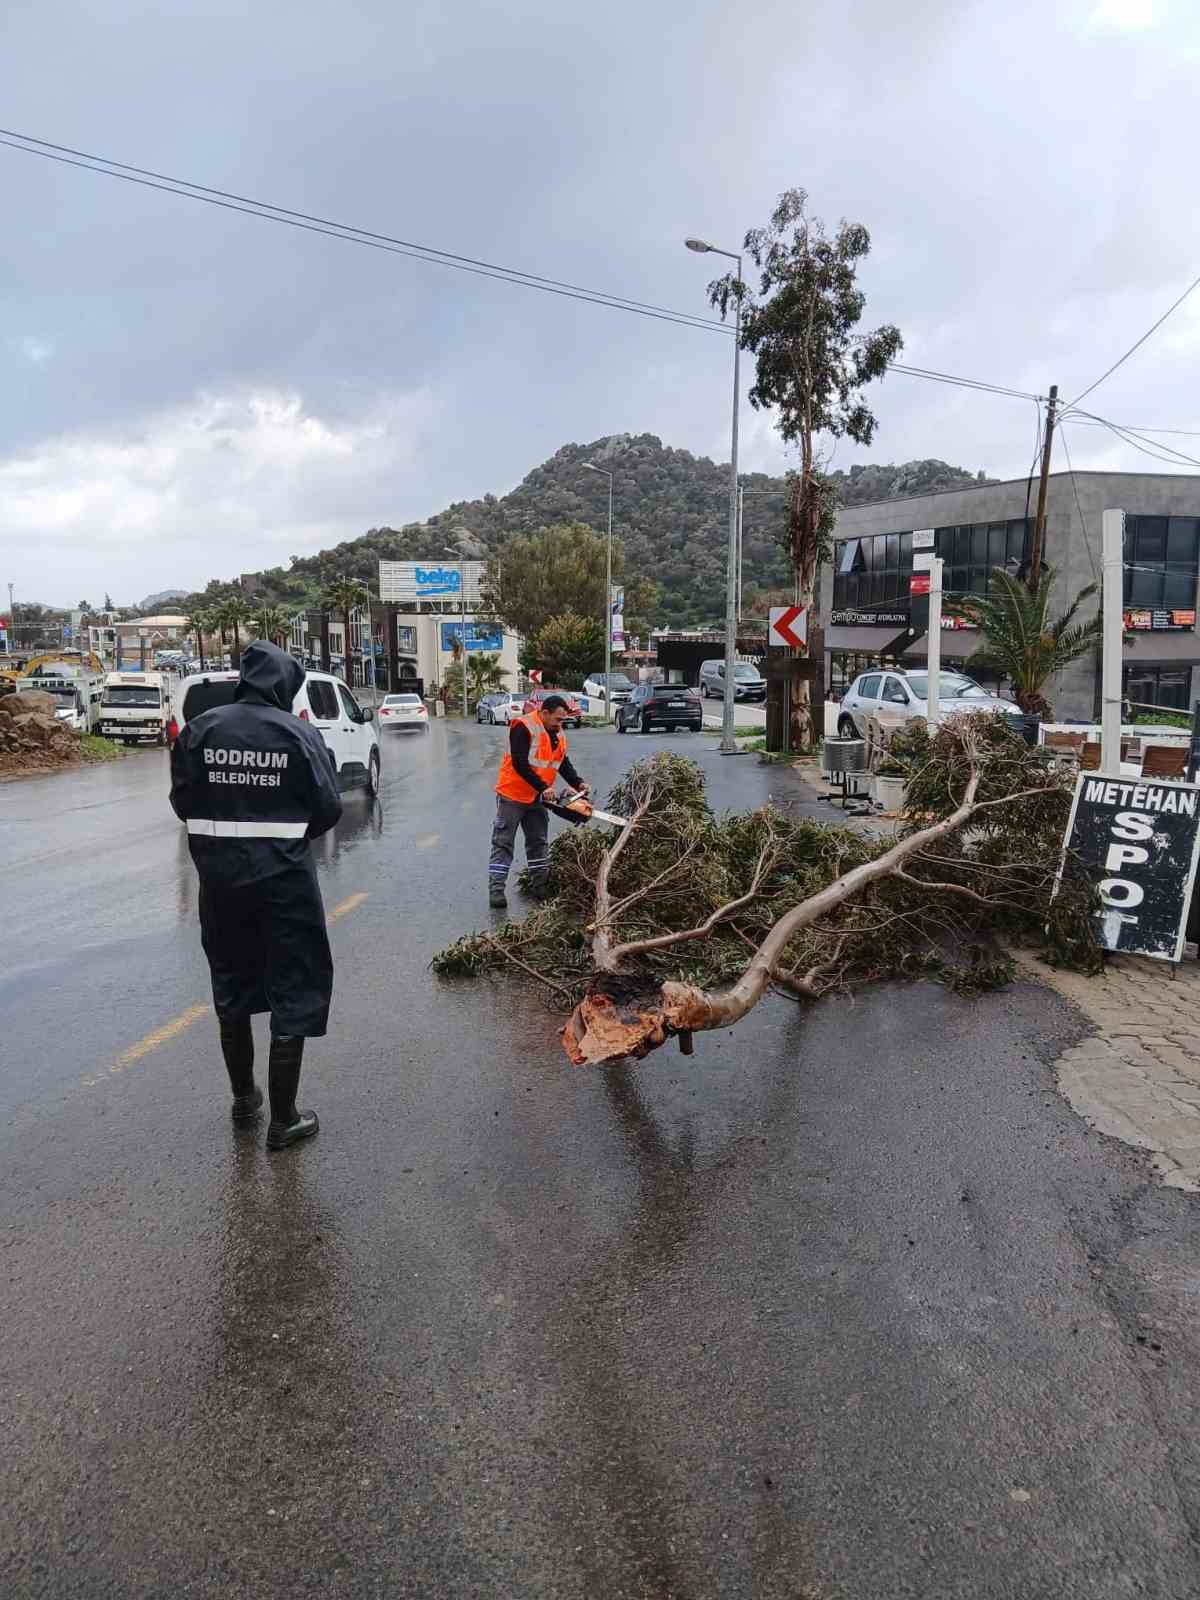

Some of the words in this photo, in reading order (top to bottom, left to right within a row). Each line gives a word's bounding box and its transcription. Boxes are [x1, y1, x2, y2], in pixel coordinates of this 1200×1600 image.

[415, 566, 460, 593] beko
[203, 748, 288, 768] BODRUM
[208, 771, 281, 786] BELEDİYESİ
[1084, 780, 1196, 817] METEHAN
